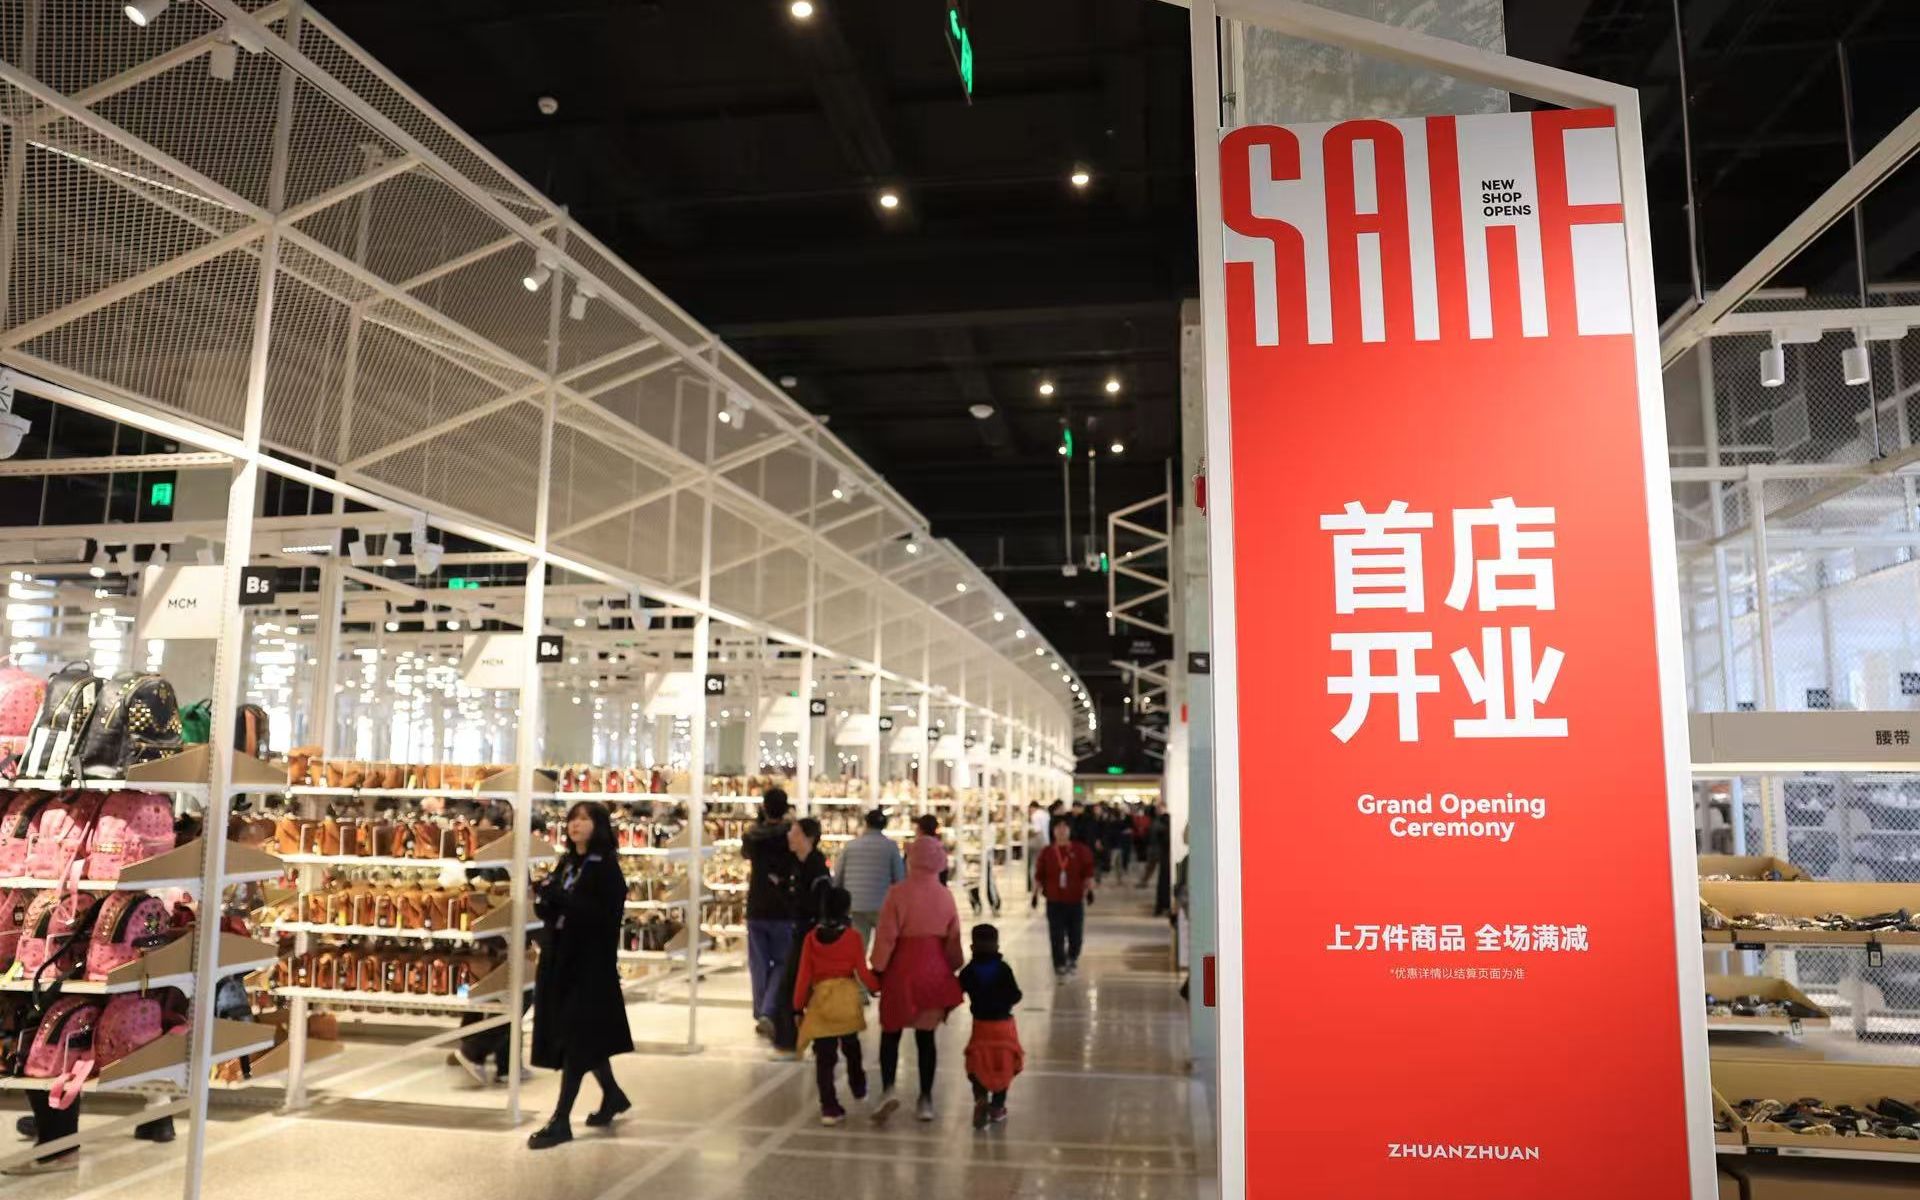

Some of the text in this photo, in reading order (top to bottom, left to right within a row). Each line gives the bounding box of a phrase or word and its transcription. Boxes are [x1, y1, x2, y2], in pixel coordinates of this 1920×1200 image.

[1481, 179, 1515, 191] NEW
[1482, 191, 1522, 204] SHOP
[1483, 204, 1532, 217] OPENS
[1320, 497, 1556, 614] 首店
[245, 576, 270, 594] B5
[167, 598, 197, 609] MCM
[1327, 626, 1568, 744] 开业
[1875, 729, 1911, 746] 腰带
[1356, 792, 1546, 819] Grand Opening
[1388, 816, 1515, 842] Ceremony
[1326, 923, 1589, 952] 上万件商品 全场满减
[1387, 1143, 1540, 1160] ZHUANZHUAN
